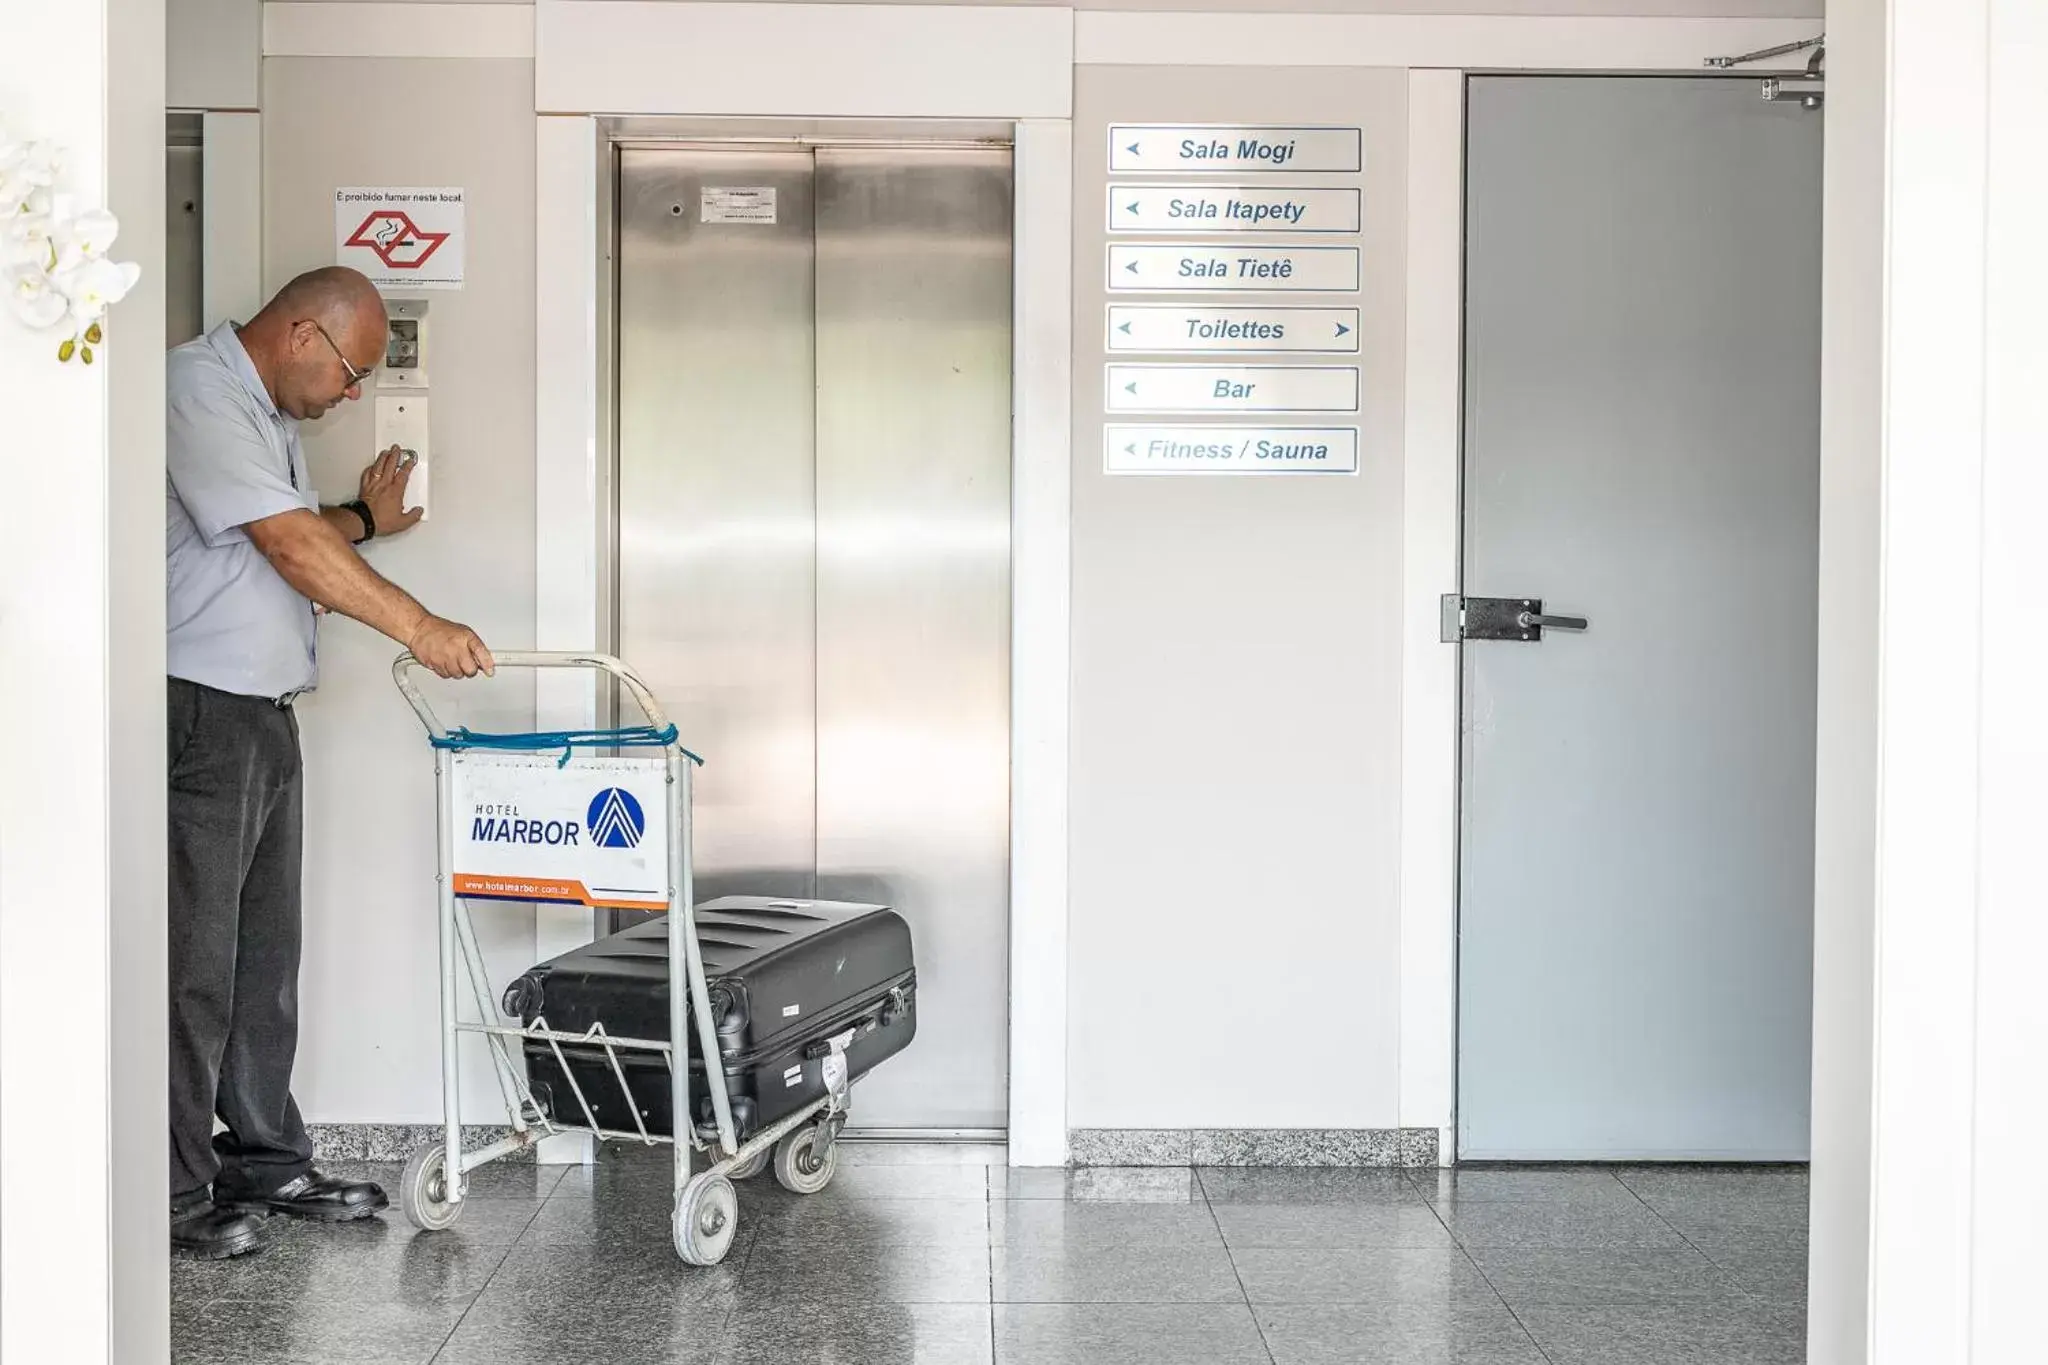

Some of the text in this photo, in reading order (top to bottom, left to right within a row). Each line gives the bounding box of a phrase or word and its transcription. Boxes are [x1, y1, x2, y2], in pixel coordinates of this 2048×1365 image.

[1179, 140, 1295, 164] Sala Mogi
[336, 191, 344, 201] É
[345, 192, 383, 202] proibido
[385, 192, 411, 201] fumar
[413, 193, 437, 202] neste
[1168, 199, 1306, 224] Sala Itapety
[1178, 258, 1292, 278] Sala Tietê
[1186, 319, 1284, 339] Toilettes
[1213, 379, 1256, 398] Bar
[1147, 439, 1329, 460] Fitness / Sauna
[475, 804, 520, 816] HOTEL
[471, 817, 580, 846] MARBOR
[464, 880, 570, 895] www.hotelmarbor.com.br
